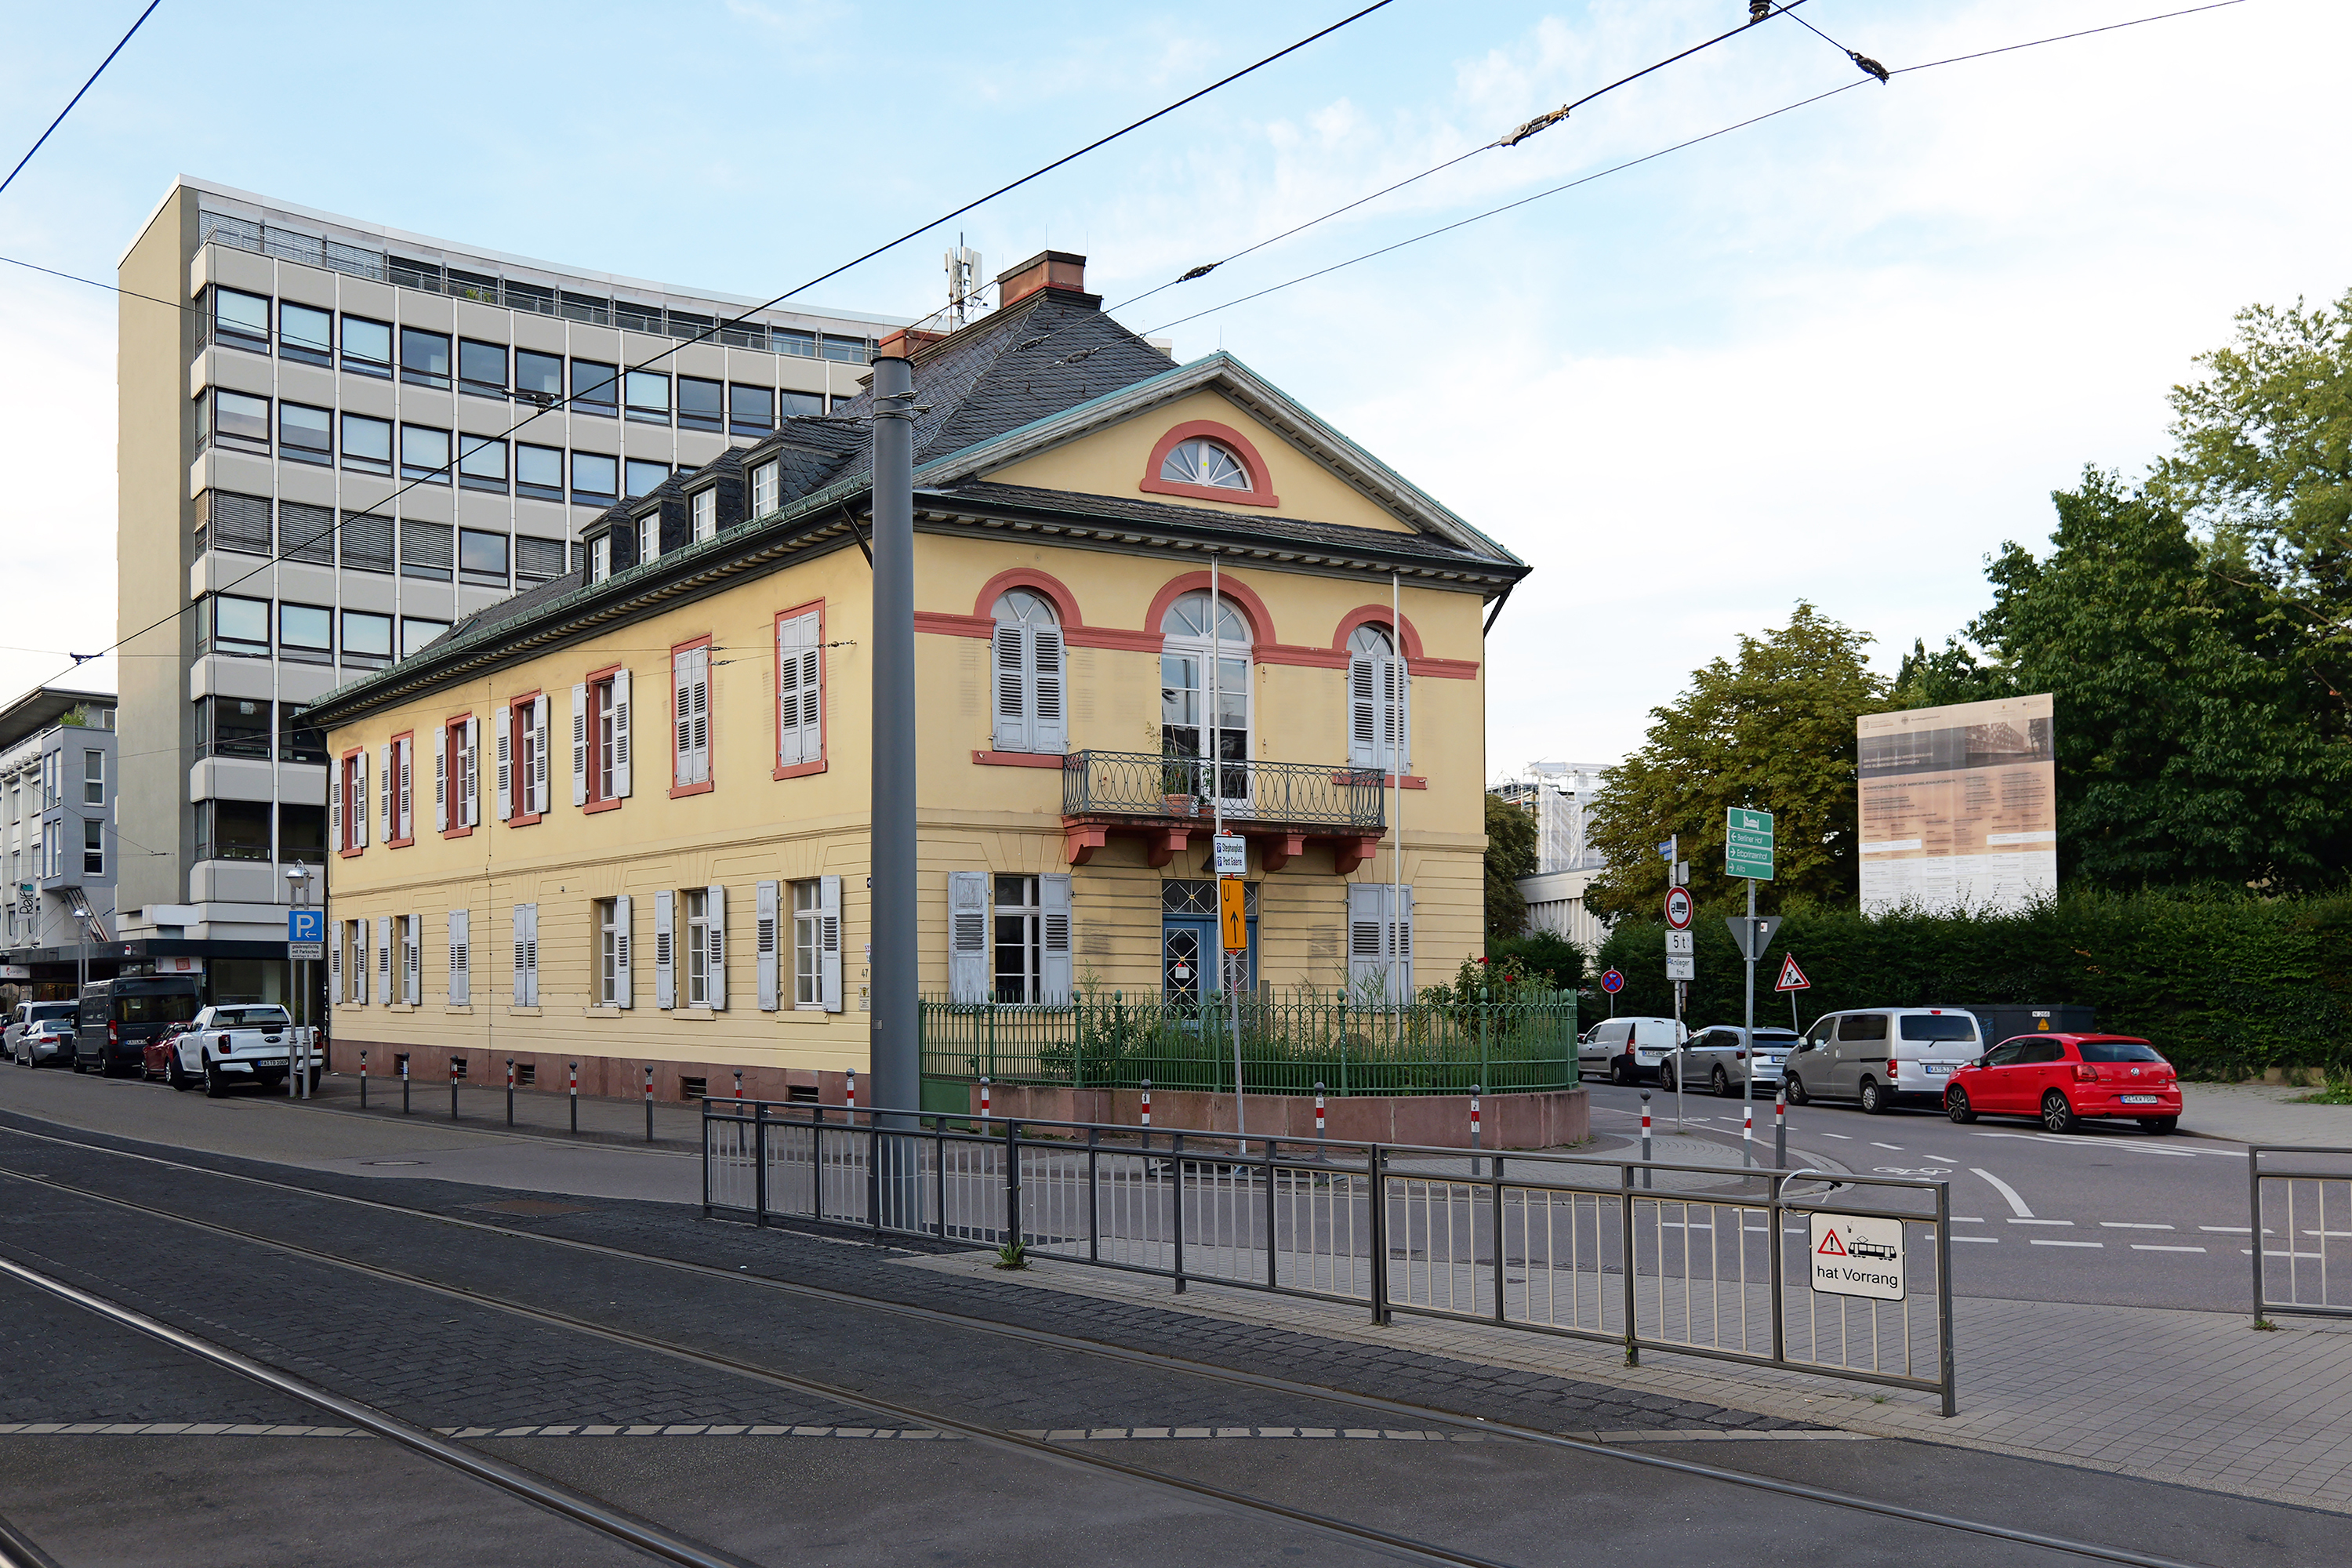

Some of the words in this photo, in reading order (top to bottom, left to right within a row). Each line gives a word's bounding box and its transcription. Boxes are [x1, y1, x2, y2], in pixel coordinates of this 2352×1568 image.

[1737, 833, 1754, 843] Berliner
[1755, 836, 1763, 844] Hof
[1222, 843, 1243, 855] Stephanplatz
[1737, 849, 1767, 860] Erbprinzenhof
[1231, 856, 1243, 866] Galerie
[1223, 884, 1230, 902] U
[296, 914, 314, 938] P
[1673, 935, 1679, 949] 5
[1670, 959, 1690, 968] Anlieger
[861, 968, 869, 978] 47
[1817, 1265, 1838, 1279] hat
[1842, 1267, 1898, 1289] Vorrang
